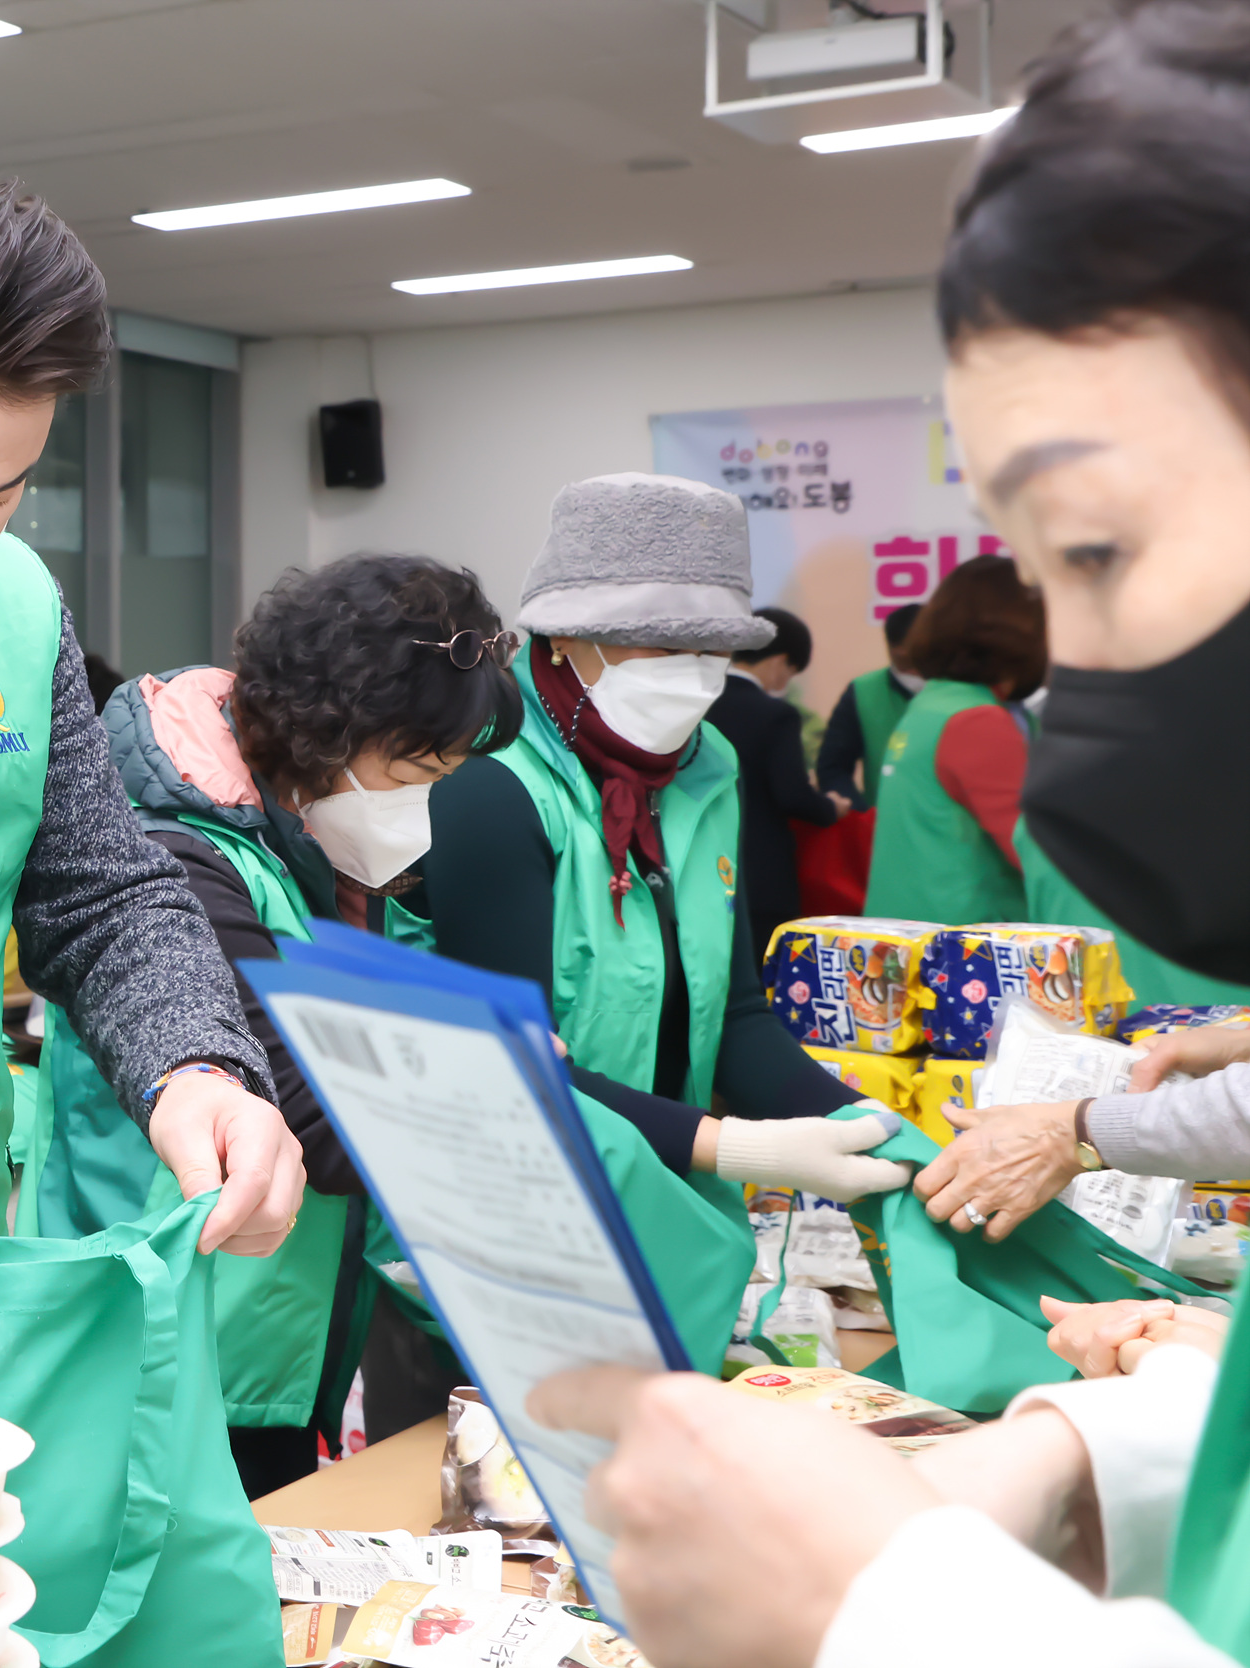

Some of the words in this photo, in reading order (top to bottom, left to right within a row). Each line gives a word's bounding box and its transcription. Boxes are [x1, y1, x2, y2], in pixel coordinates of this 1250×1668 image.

[720, 438, 829, 464] dobong
[803, 481, 852, 514] 도봉
[814, 948, 857, 1048] 진라면
